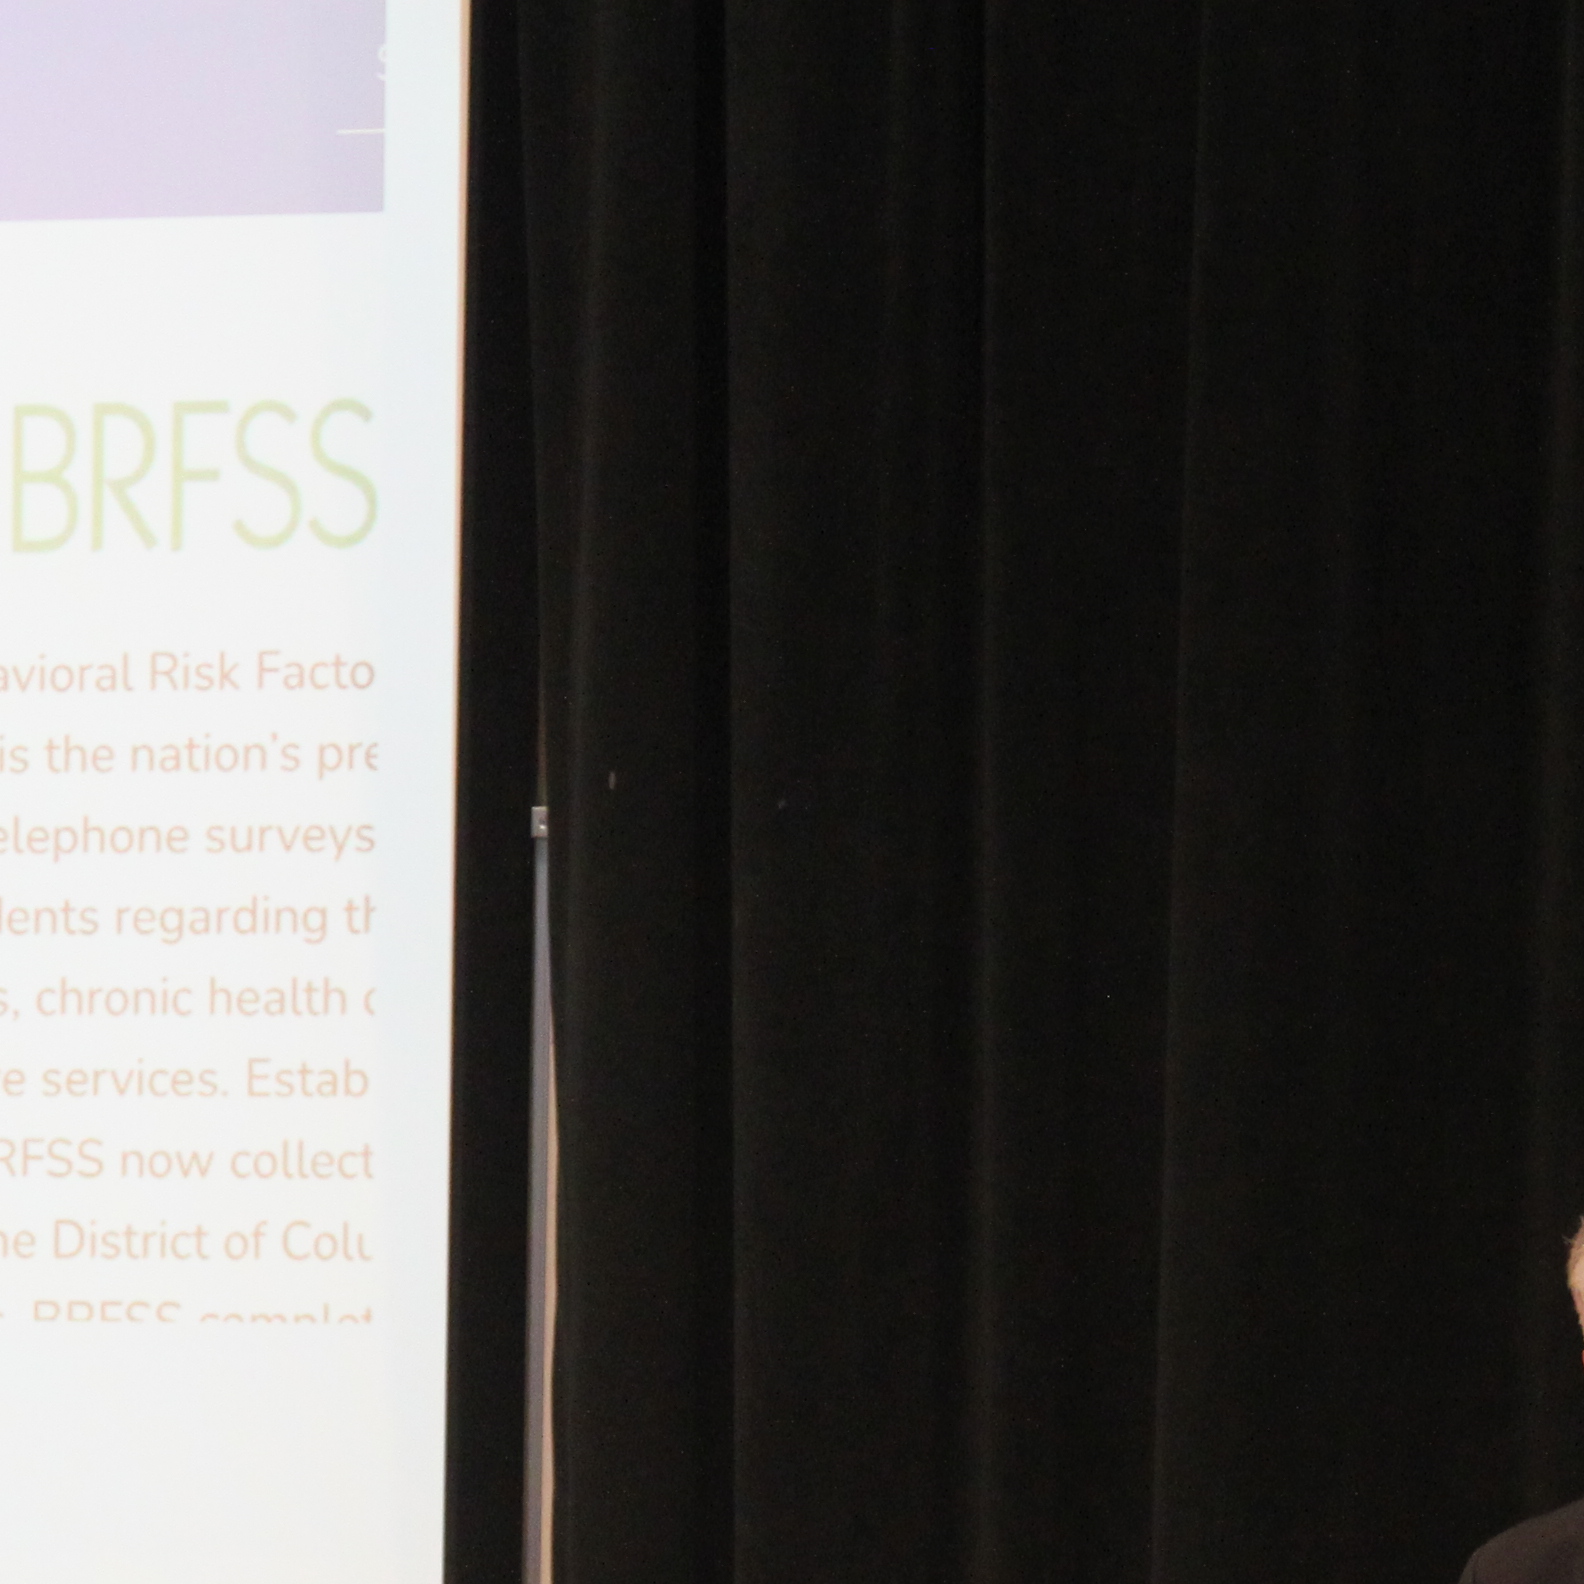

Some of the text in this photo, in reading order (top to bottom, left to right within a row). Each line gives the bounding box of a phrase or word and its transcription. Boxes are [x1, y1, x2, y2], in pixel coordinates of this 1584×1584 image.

[12, 398, 377, 553] BRFSS
[149, 651, 239, 691] Risk
[257, 650, 376, 690] Facto
[44, 735, 115, 773] the
[131, 732, 301, 772] nation's
[205, 823, 376, 861] surveys
[116, 895, 328, 945] regarding
[35, 977, 192, 1017] chronic
[209, 977, 347, 1016] health
[42, 1058, 227, 1097] services.
[247, 1058, 369, 1097] Estab
[121, 1150, 214, 1179] now
[230, 1139, 373, 1180] collect
[53, 1218, 209, 1260] District
[223, 1220, 267, 1261] of
